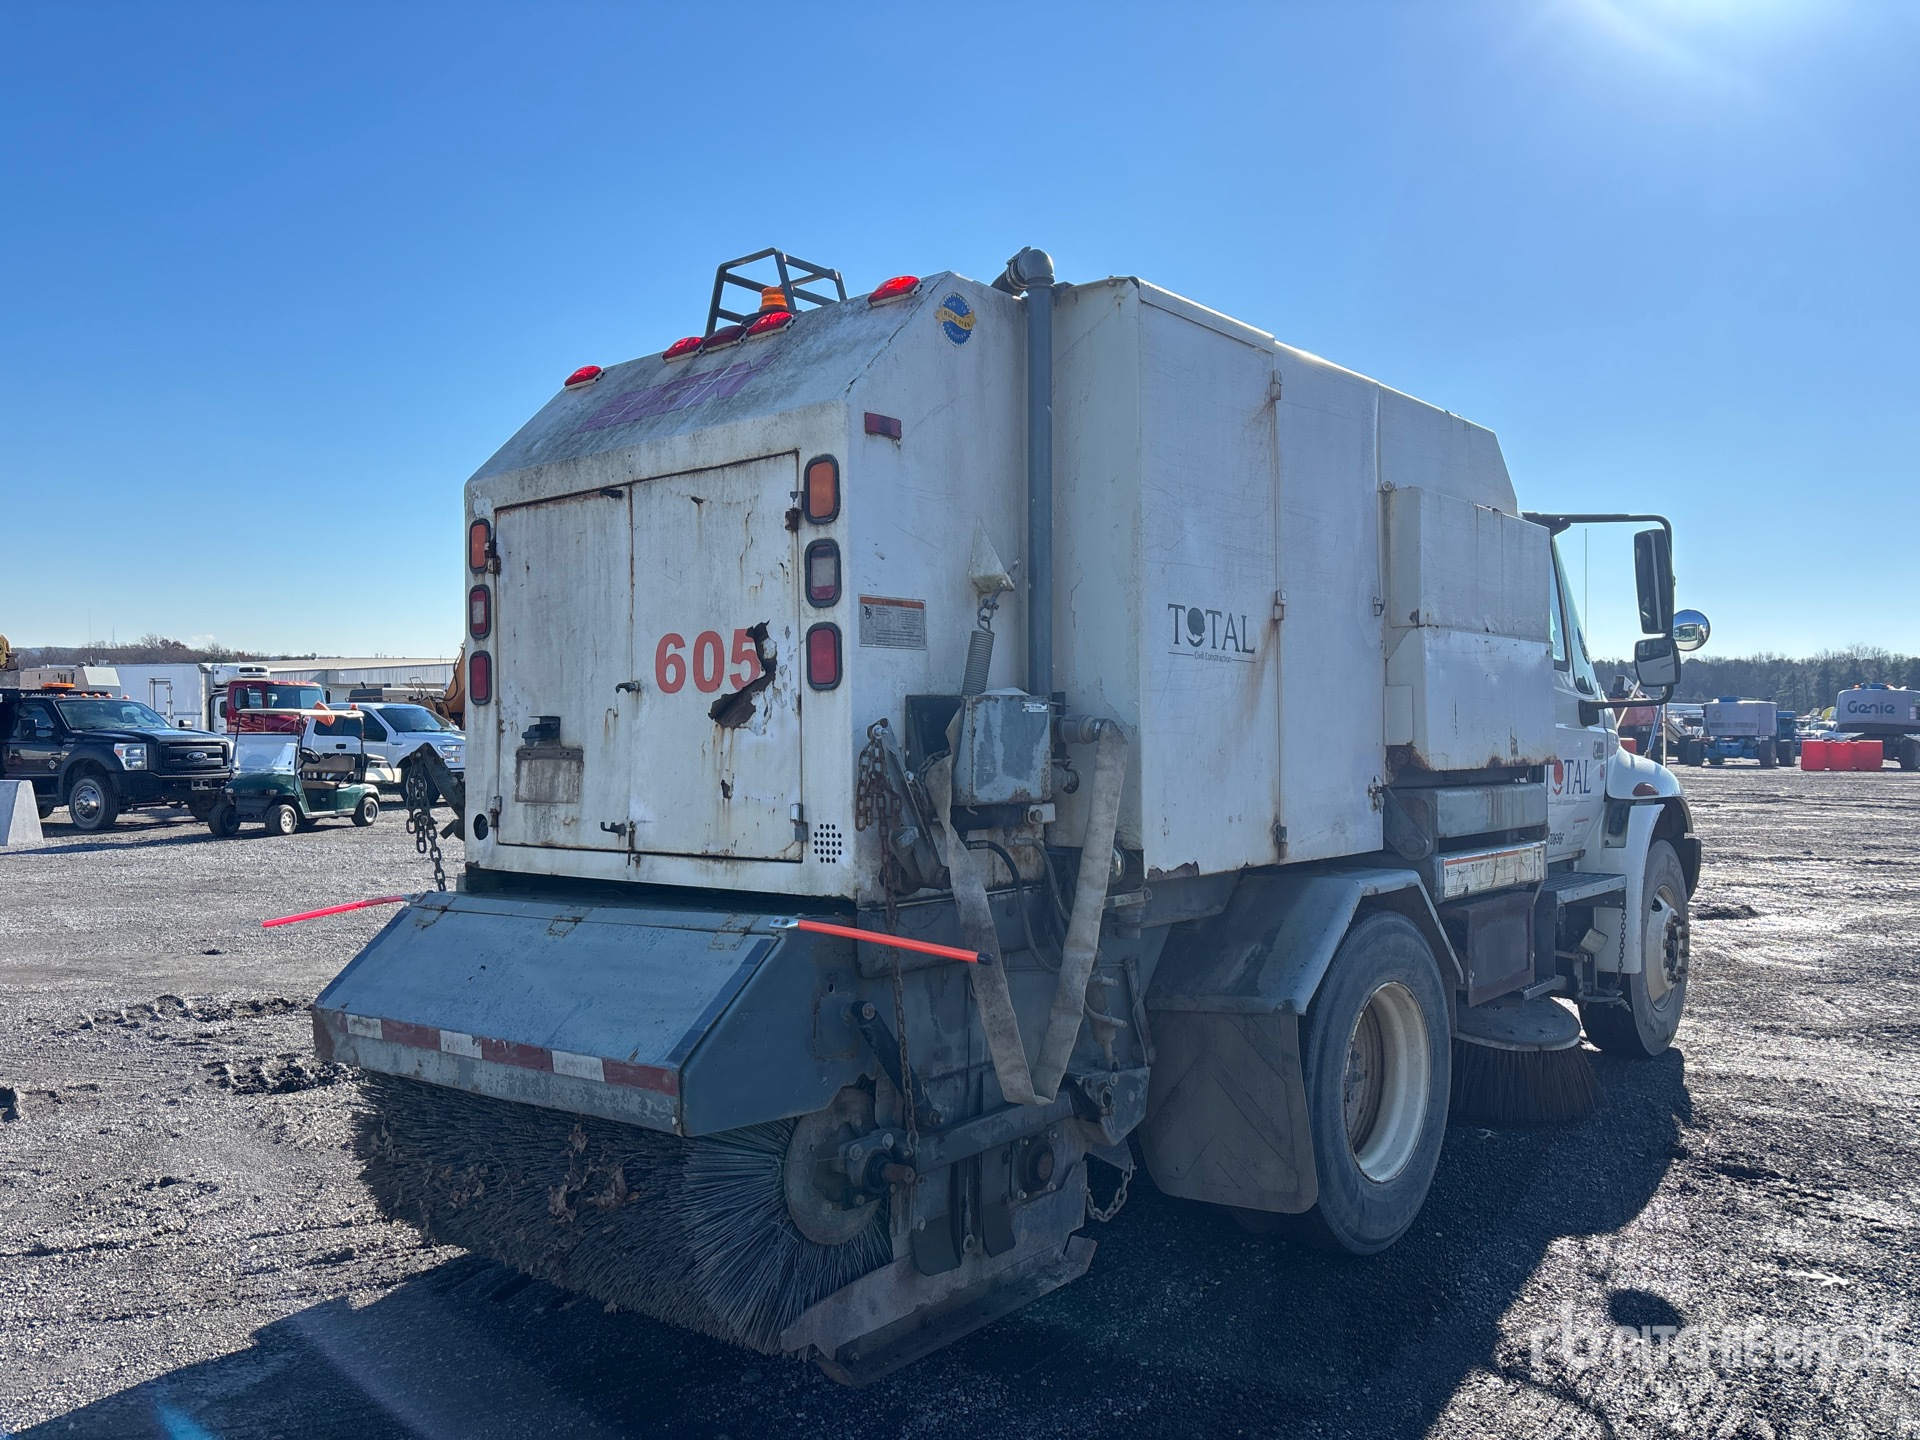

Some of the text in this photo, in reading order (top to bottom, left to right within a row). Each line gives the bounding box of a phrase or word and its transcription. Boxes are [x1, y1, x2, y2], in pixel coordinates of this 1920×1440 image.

[1167, 603, 1256, 654] TOTAL
[655, 628, 761, 694] 605
[1194, 651, 1232, 663] Civil Construction
[1847, 700, 1896, 715] Genie
